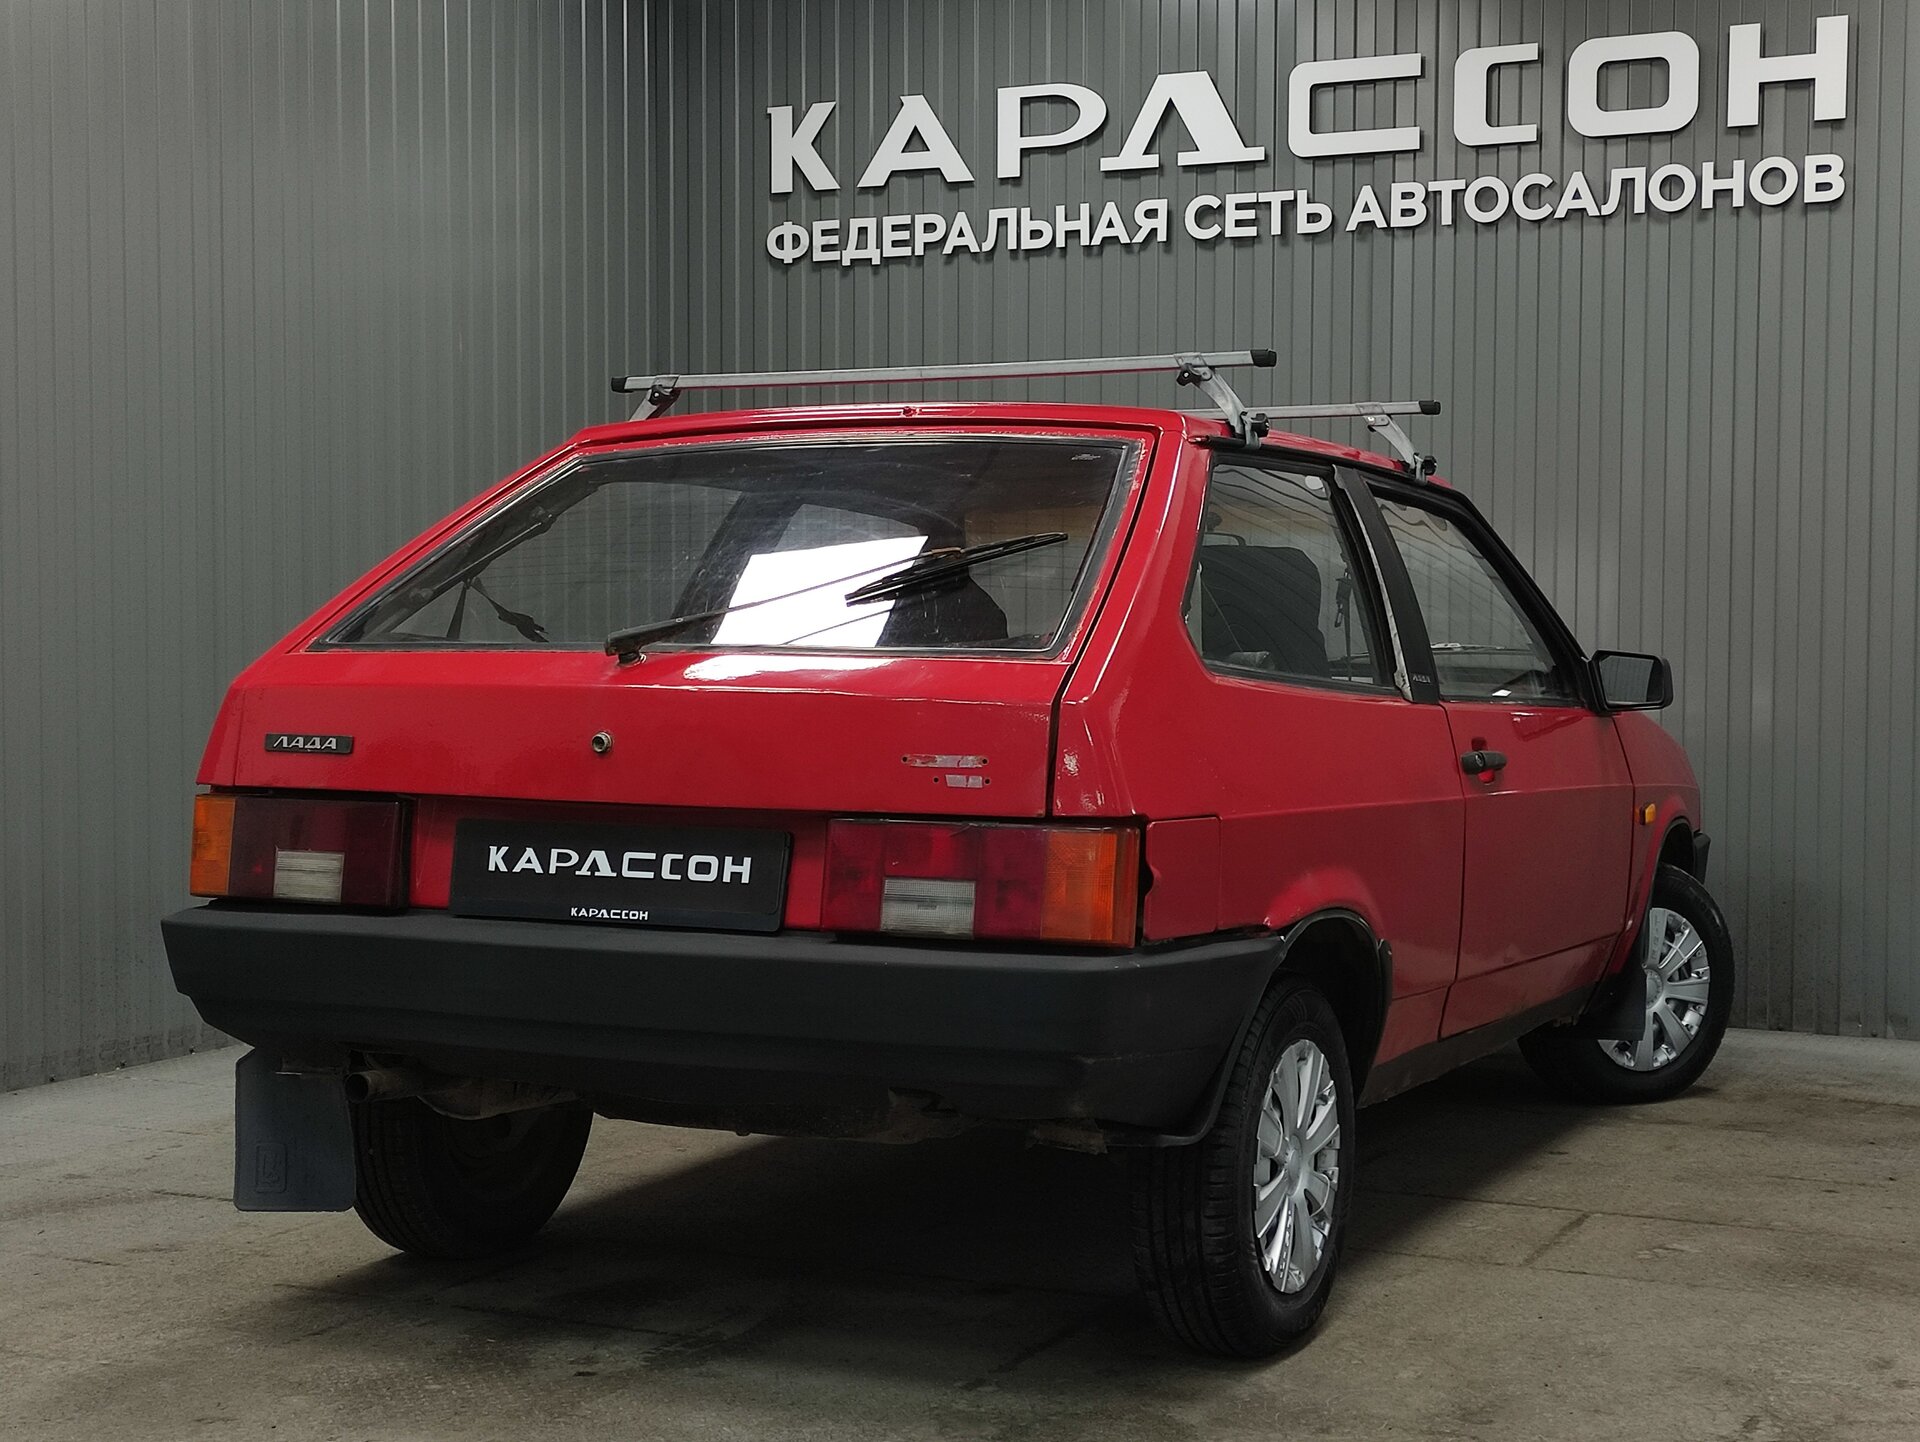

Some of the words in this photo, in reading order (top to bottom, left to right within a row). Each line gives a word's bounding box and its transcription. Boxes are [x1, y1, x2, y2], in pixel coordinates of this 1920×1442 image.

[767, 15, 1848, 194] КАРАССОН
[766, 199, 1168, 266] ФЕДЕРАЛЬНАЯ
[1184, 188, 1333, 240] СЕТЬ
[1345, 153, 1847, 232] АВТОСАЛОНОВ
[273, 735, 338, 750] ЛАДА
[487, 845, 752, 884] КАРАССОН
